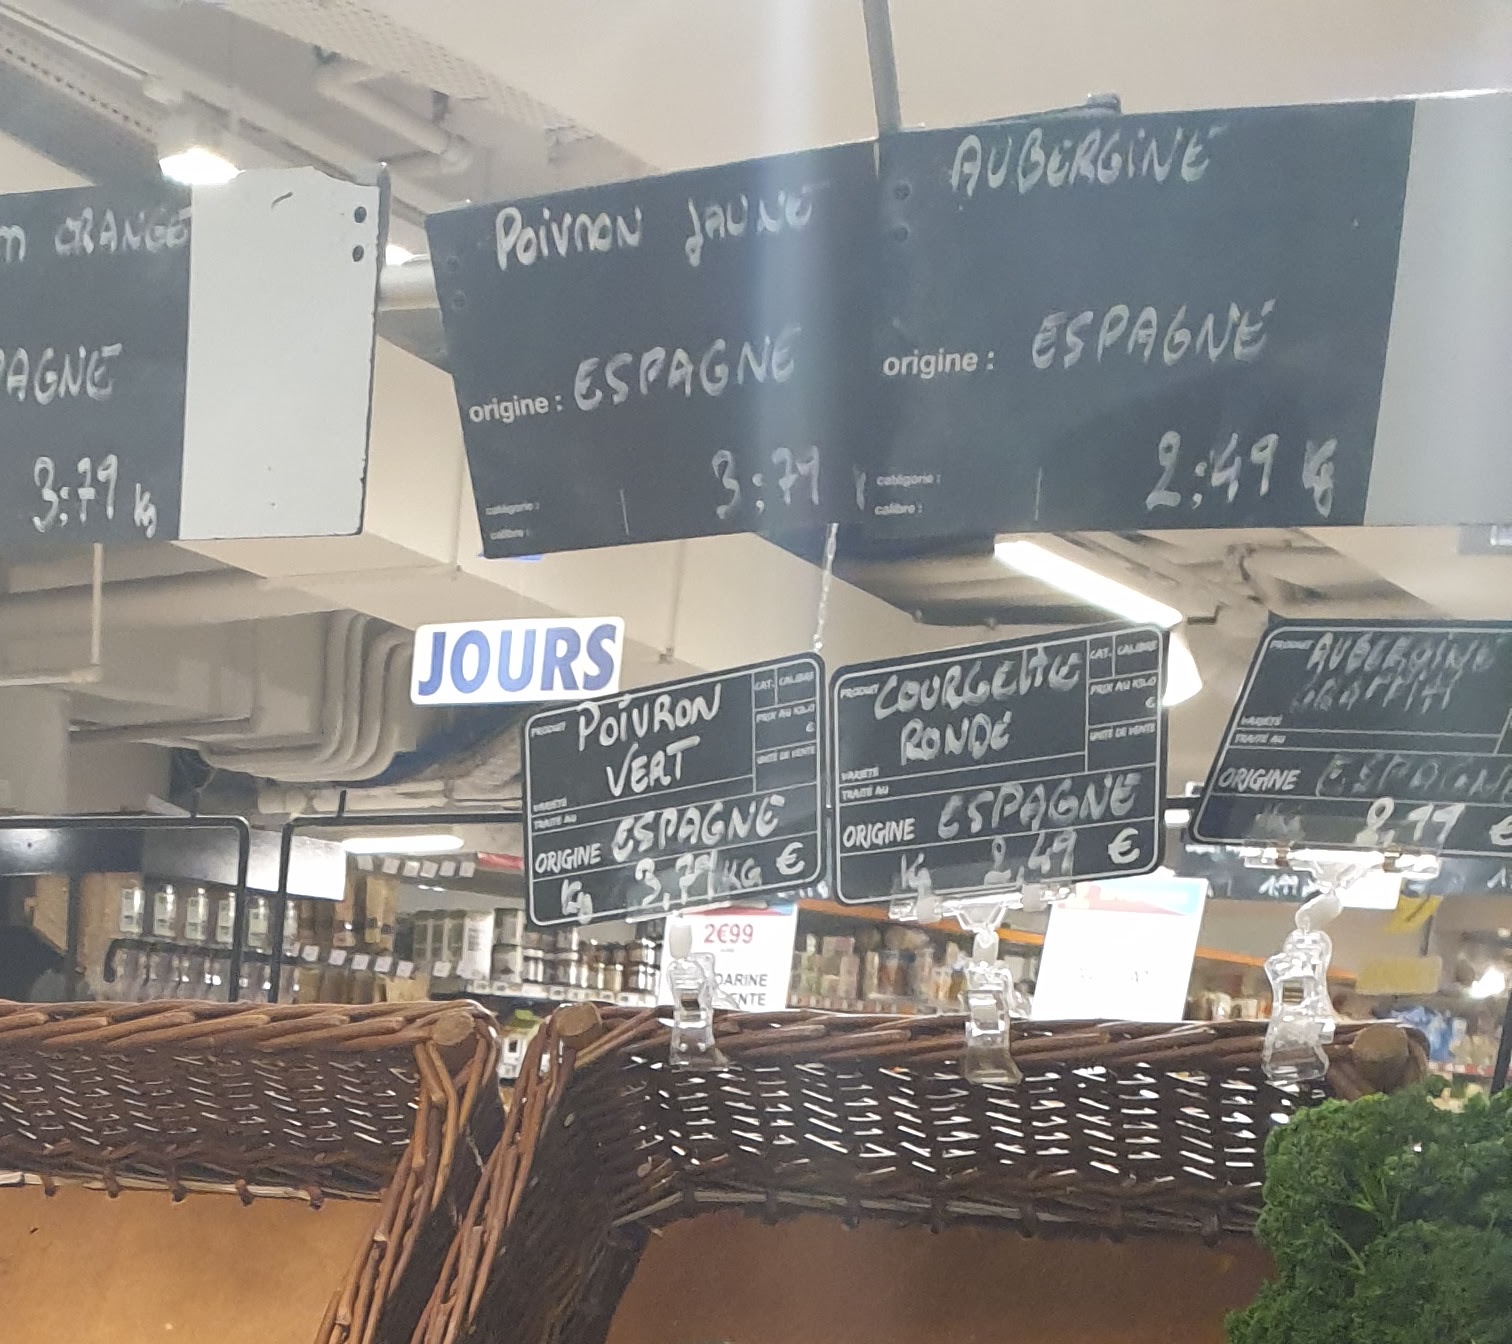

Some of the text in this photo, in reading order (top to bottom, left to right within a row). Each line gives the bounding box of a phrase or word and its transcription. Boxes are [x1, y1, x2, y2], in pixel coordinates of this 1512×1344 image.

[418, 623, 617, 696] JOURS
[606, 735, 700, 797] VERT
[1218, 768, 1301, 792] ORIGINE
[843, 818, 915, 849] ORIGINE
[1108, 828, 1140, 864] €
[535, 843, 601, 874] ORIGINE
[776, 842, 805, 875] €
[703, 923, 754, 944] 2€99
